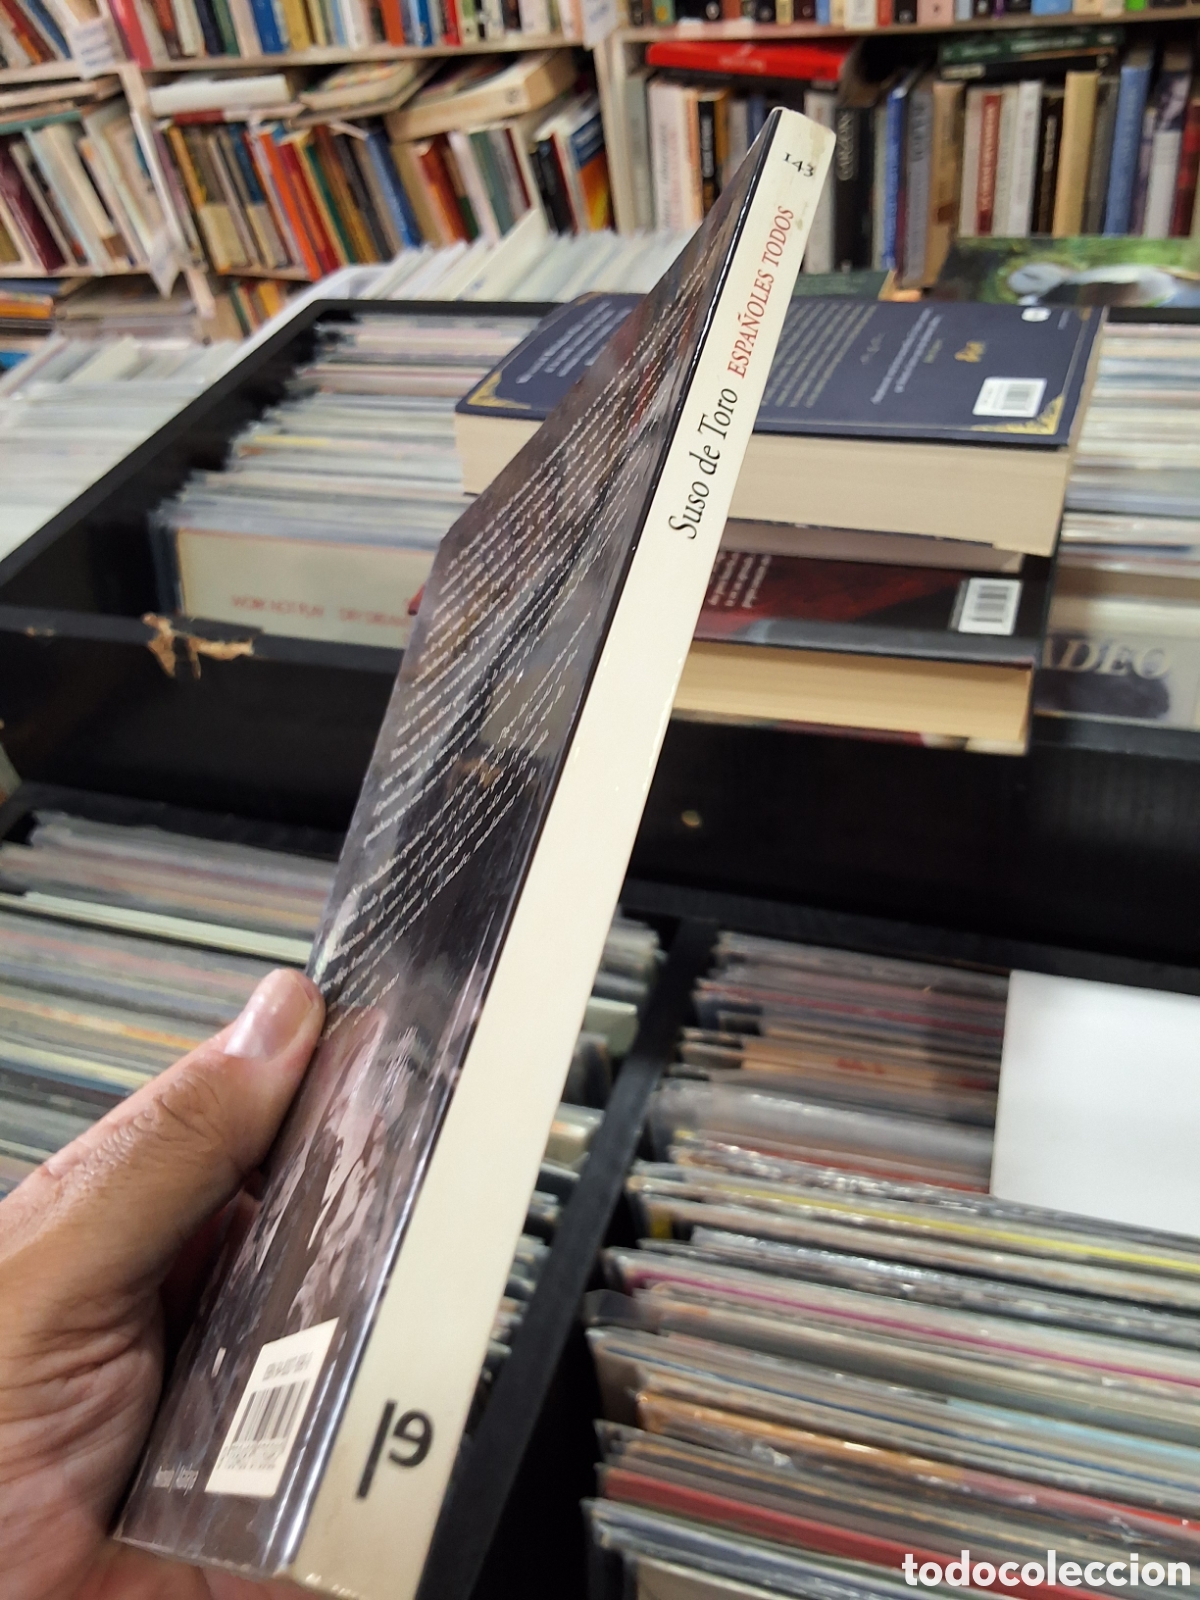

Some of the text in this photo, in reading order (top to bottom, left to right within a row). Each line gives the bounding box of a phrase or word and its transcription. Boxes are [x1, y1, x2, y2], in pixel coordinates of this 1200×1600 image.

[783, 151, 814, 178] 143
[668, 205, 794, 540] Suso de Toro ESPAÑOLES TODOS
